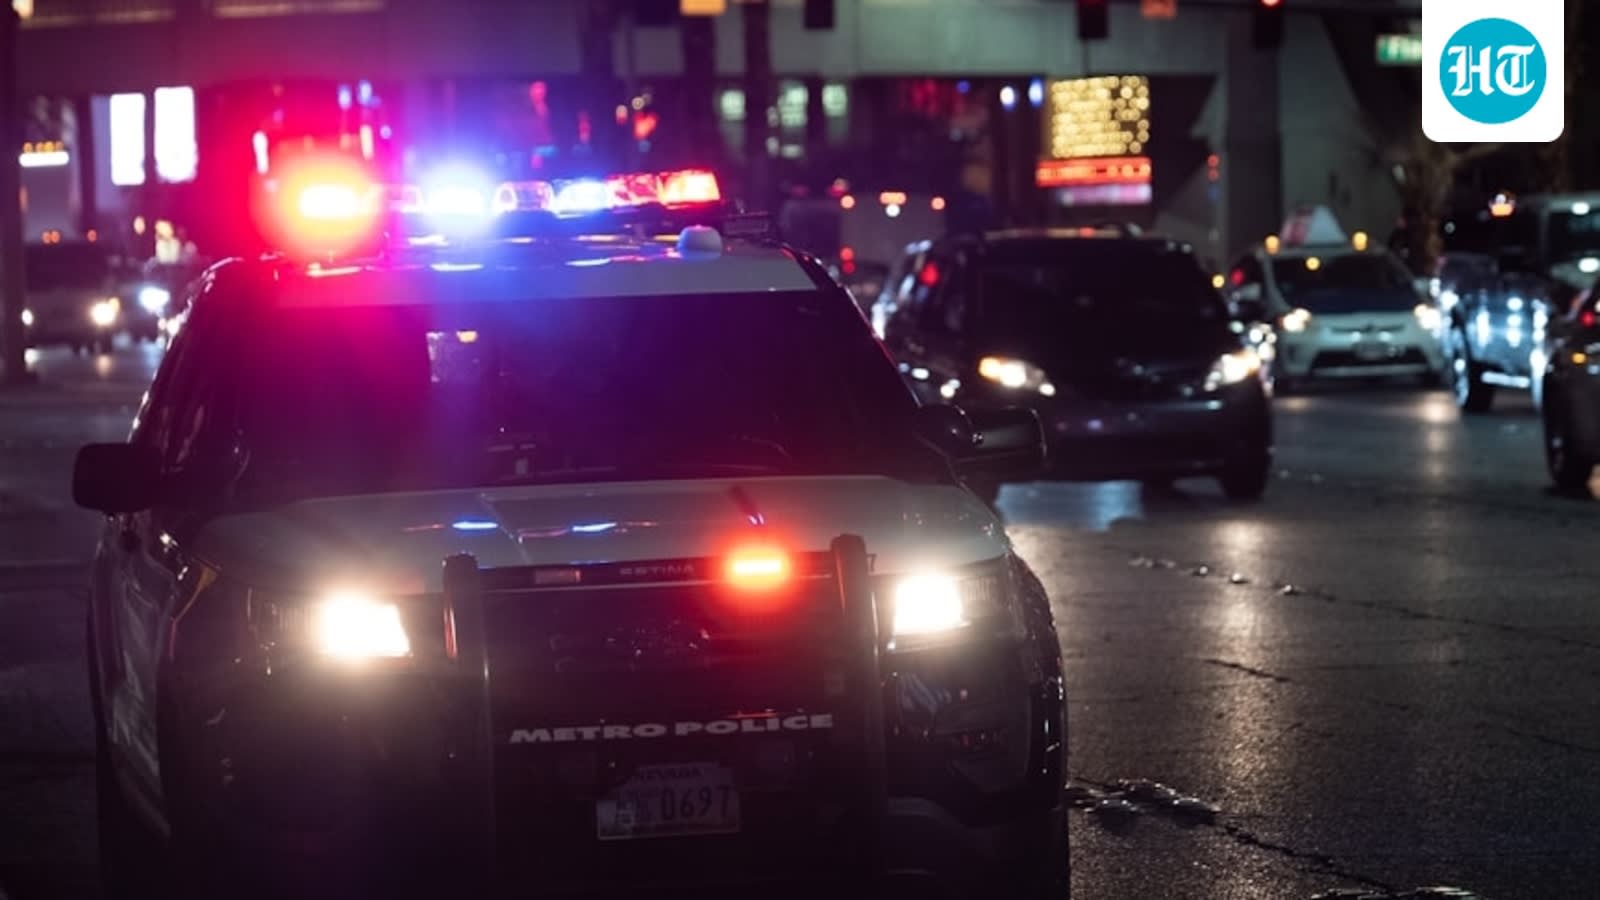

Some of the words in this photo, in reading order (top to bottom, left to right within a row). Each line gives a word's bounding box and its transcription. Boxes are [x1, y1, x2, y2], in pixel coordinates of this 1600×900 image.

[510, 723, 667, 743] METRO
[675, 714, 834, 736] POLICE
[661, 785, 731, 820] 0697
